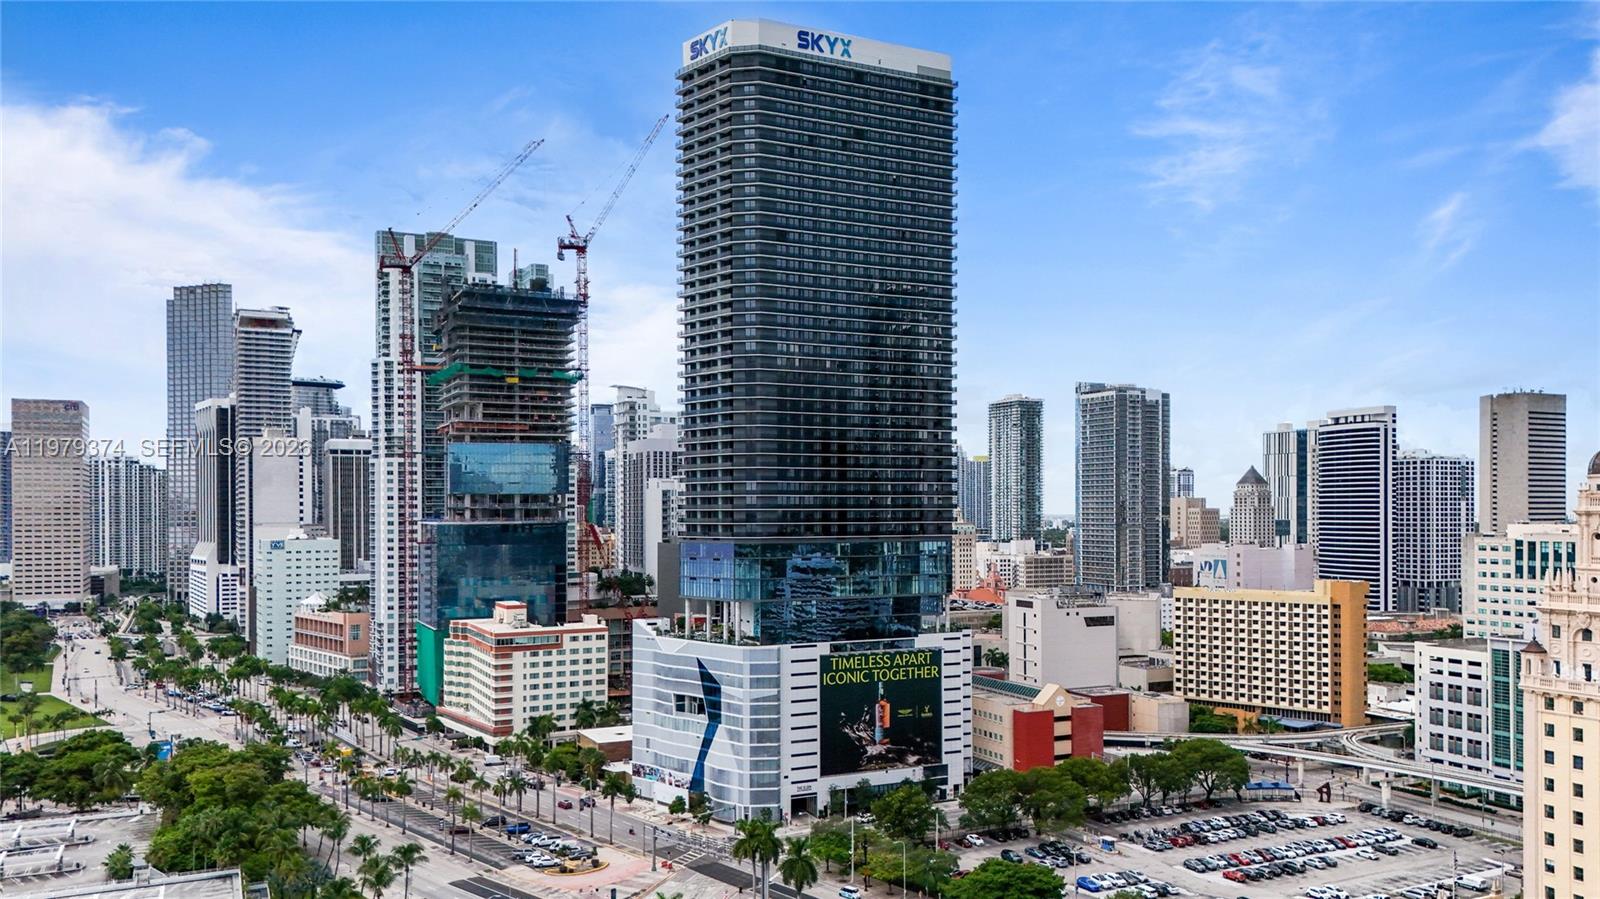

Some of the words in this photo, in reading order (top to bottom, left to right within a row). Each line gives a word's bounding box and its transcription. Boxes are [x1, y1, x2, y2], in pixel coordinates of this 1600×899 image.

[690, 26, 728, 61] SKYX
[797, 30, 852, 58] SKYX
[830, 654, 891, 670] TIMELESS
[893, 652, 932, 666] APART
[823, 670, 870, 685] ICONIC
[872, 665, 939, 682] TOGETHER
